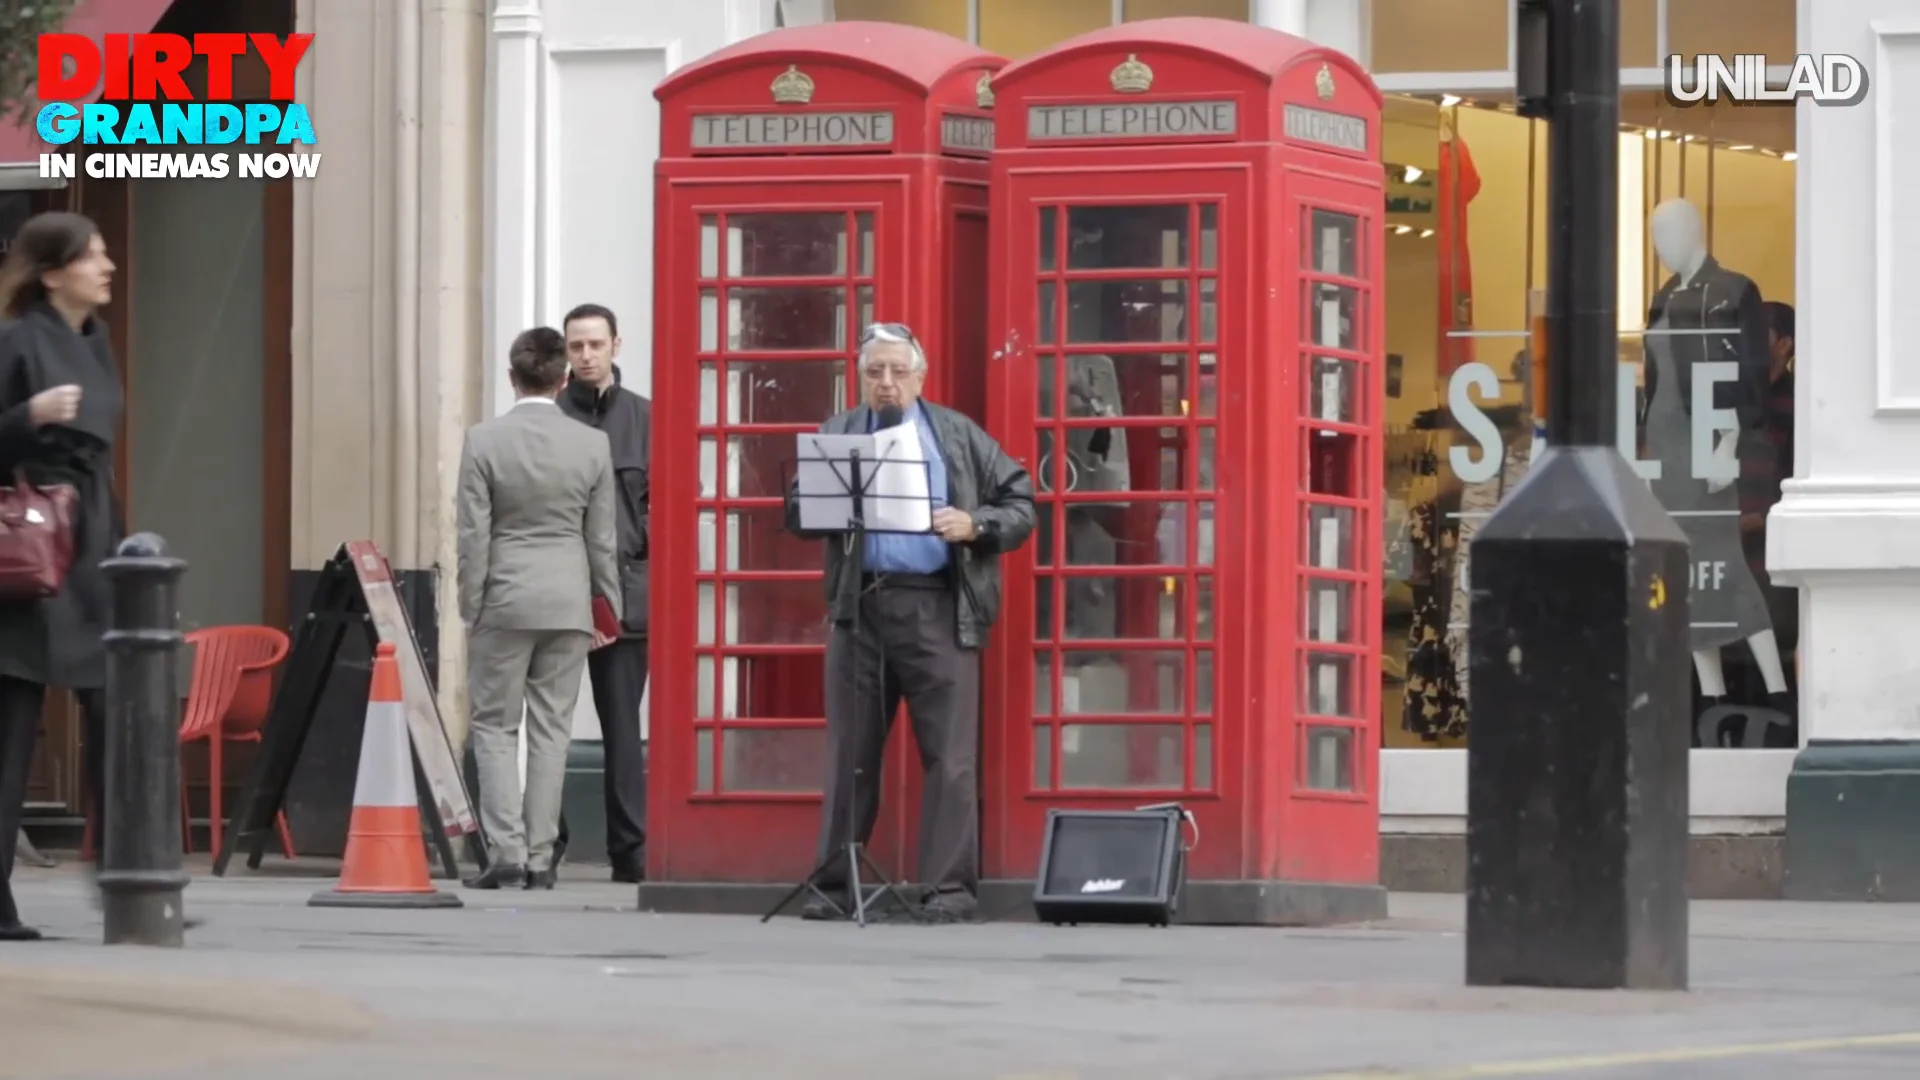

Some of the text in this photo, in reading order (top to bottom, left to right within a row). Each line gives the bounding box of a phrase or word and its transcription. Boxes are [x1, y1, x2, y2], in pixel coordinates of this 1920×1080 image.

[703, 114, 887, 144] TELEPHONE
[1037, 104, 1229, 136] TELEPHONE
[1286, 106, 1364, 150] TELEPHONE
[1448, 361, 1740, 483] SLE
